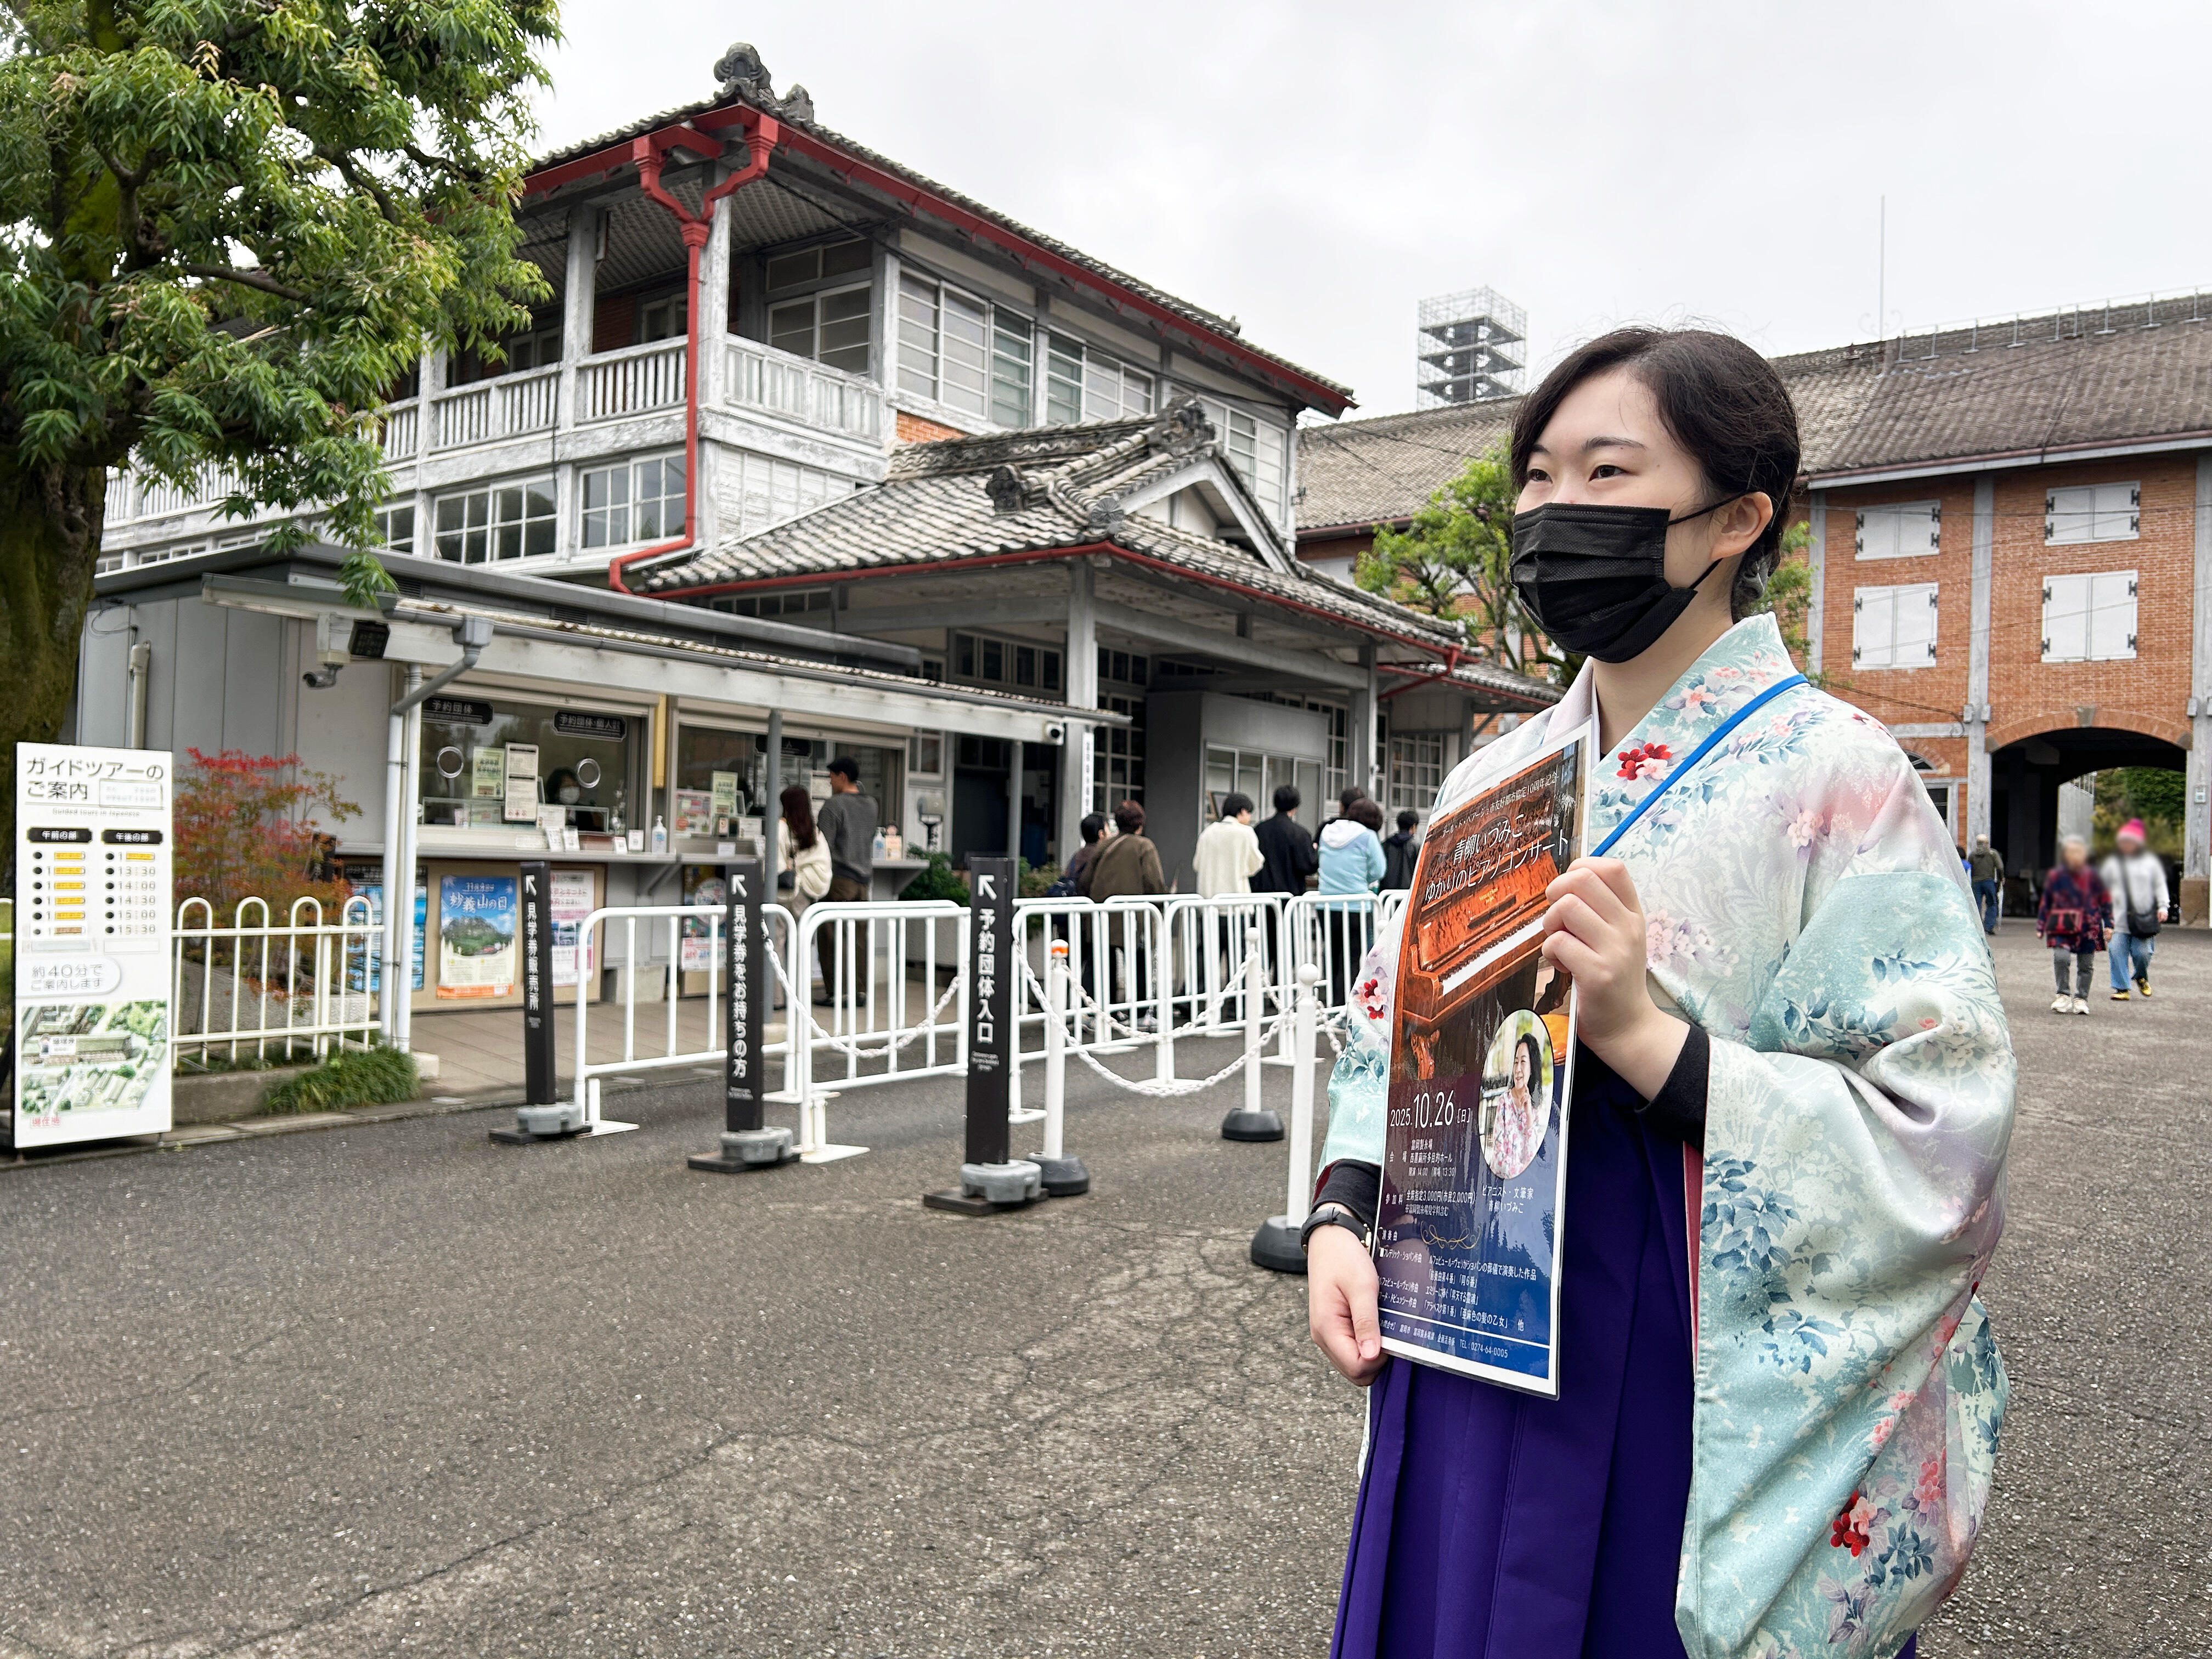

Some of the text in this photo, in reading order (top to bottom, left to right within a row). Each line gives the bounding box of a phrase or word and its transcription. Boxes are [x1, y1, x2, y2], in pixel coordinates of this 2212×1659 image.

[432, 700, 473, 714] 予約団体
[25, 757, 164, 781] ガイドツアーの
[27, 781, 88, 801] ご案内
[42, 830, 77, 840] 午前の部
[116, 832, 149, 842] 午後の部
[1454, 814, 1524, 865] 青柳いづみこ
[118, 866, 155, 877] 13:30
[1425, 829, 1568, 904] ゆかりのピアノコンサート
[118, 881, 155, 891] 14:00
[118, 895, 155, 906] 14:30
[450, 891, 507, 913] 妙義山の日
[118, 910, 155, 920] 15:00
[118, 924, 155, 935] 15:30
[527, 901, 539, 1011] 見学券販売所
[32, 963, 103, 979] 約40分で
[977, 908, 996, 1045] 予約団体入口
[31, 978, 103, 992] ご案内します
[732, 904, 747, 1079] 見学券をお持ちの方
[1482, 1185, 1534, 1200] ピアニスト・文筆家
[1488, 1200, 1524, 1214] 青柳いづみこ
